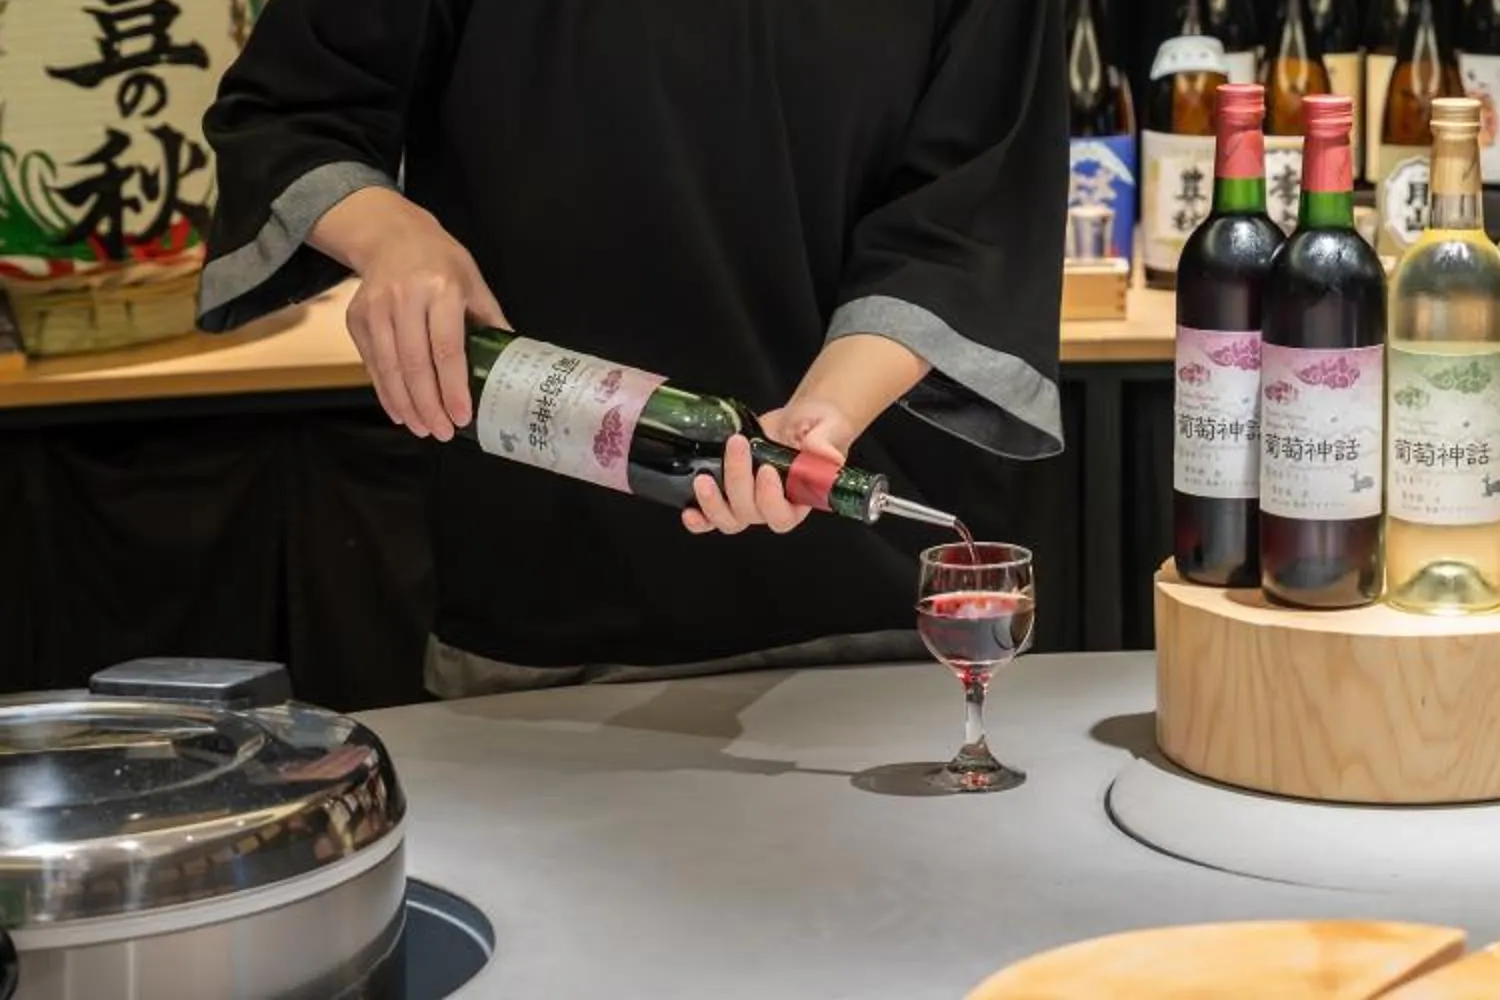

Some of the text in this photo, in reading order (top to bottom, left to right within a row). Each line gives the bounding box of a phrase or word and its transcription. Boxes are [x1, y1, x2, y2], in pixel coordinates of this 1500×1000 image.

[1265, 431, 1361, 463] 葡萄神話
[1395, 438, 1491, 469] 葡萄神話
